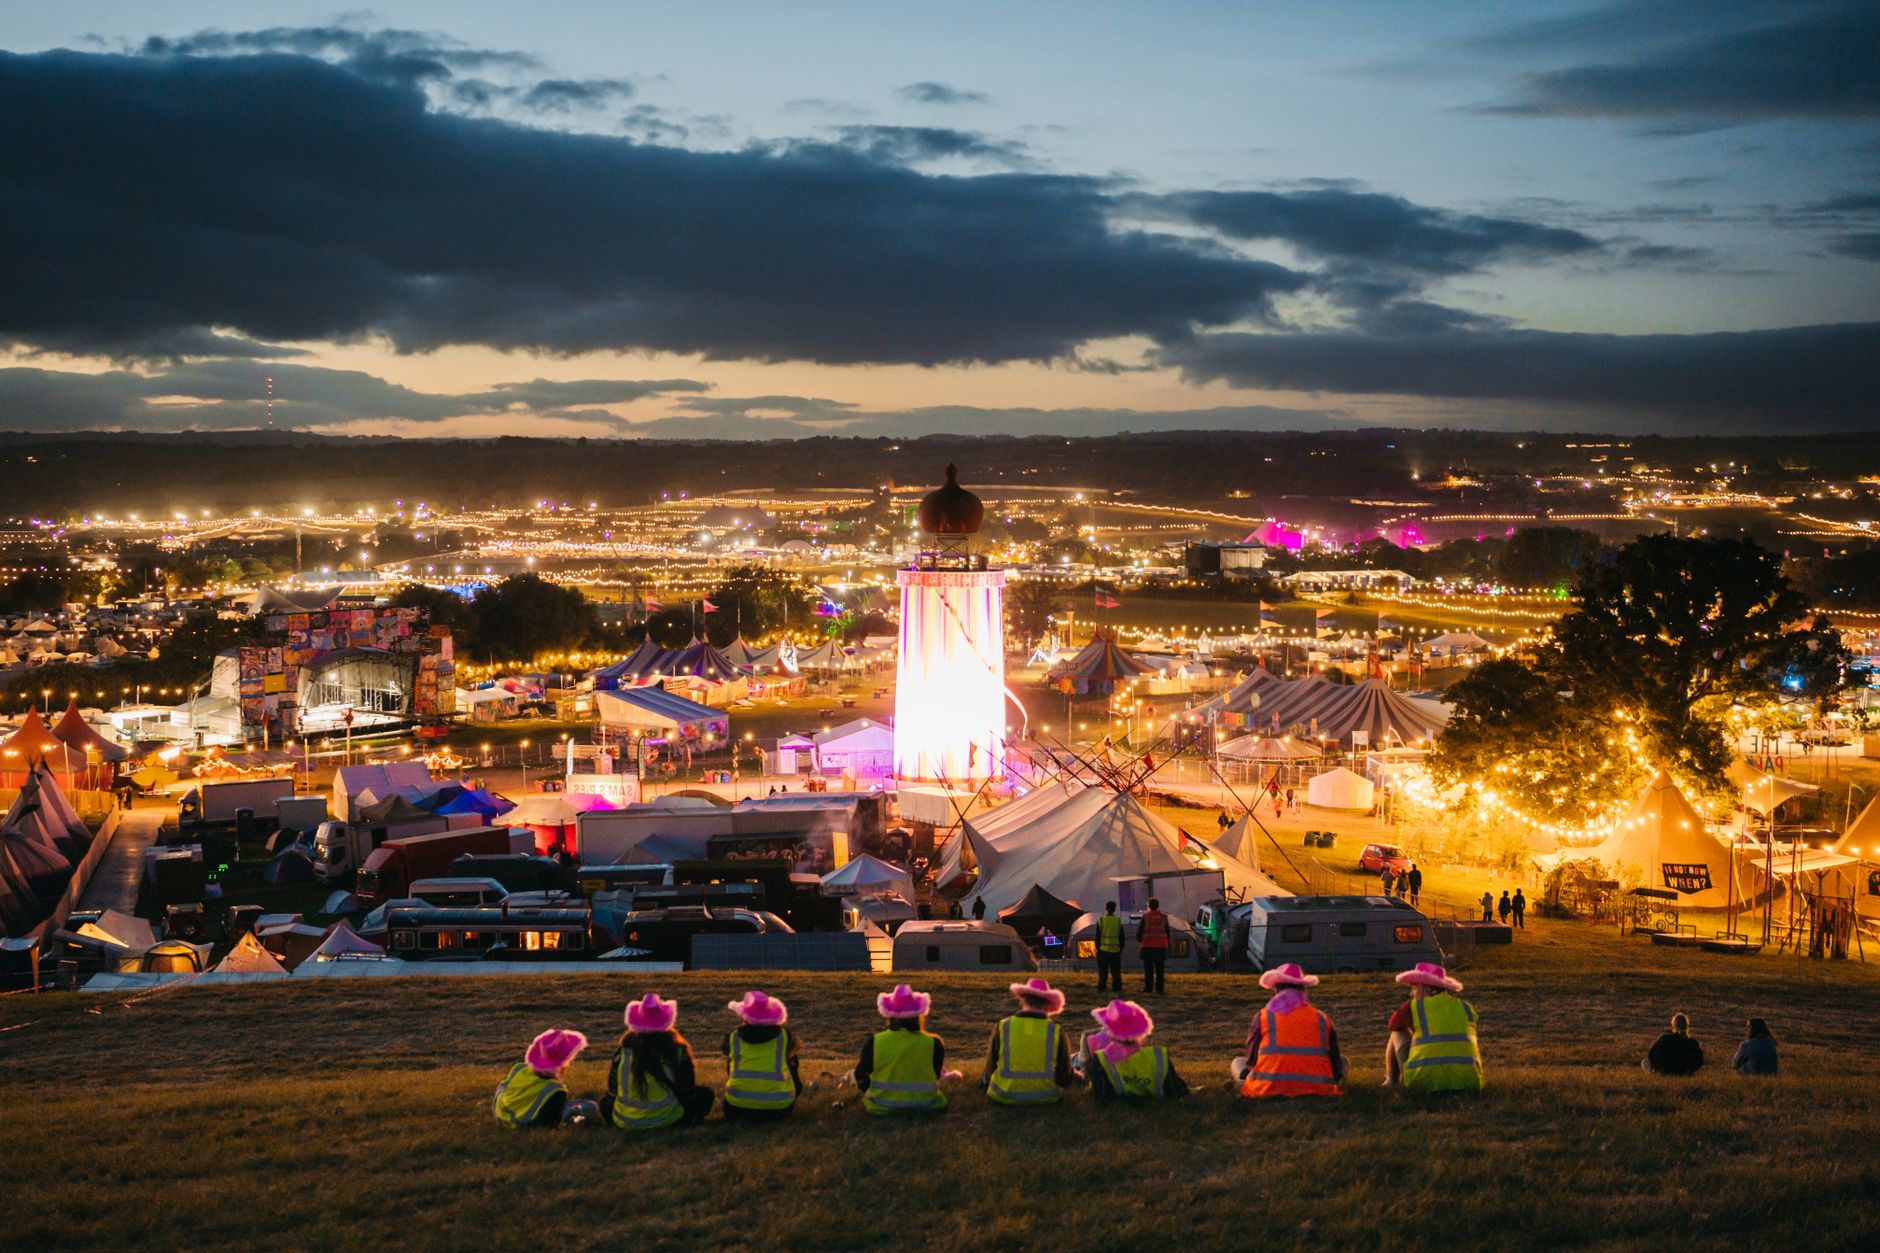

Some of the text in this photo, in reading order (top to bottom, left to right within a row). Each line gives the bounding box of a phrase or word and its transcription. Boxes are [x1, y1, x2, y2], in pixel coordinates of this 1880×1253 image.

[1664, 865, 1707, 876] IF NOT NOW
[1668, 877, 1706, 889] WHEN?
